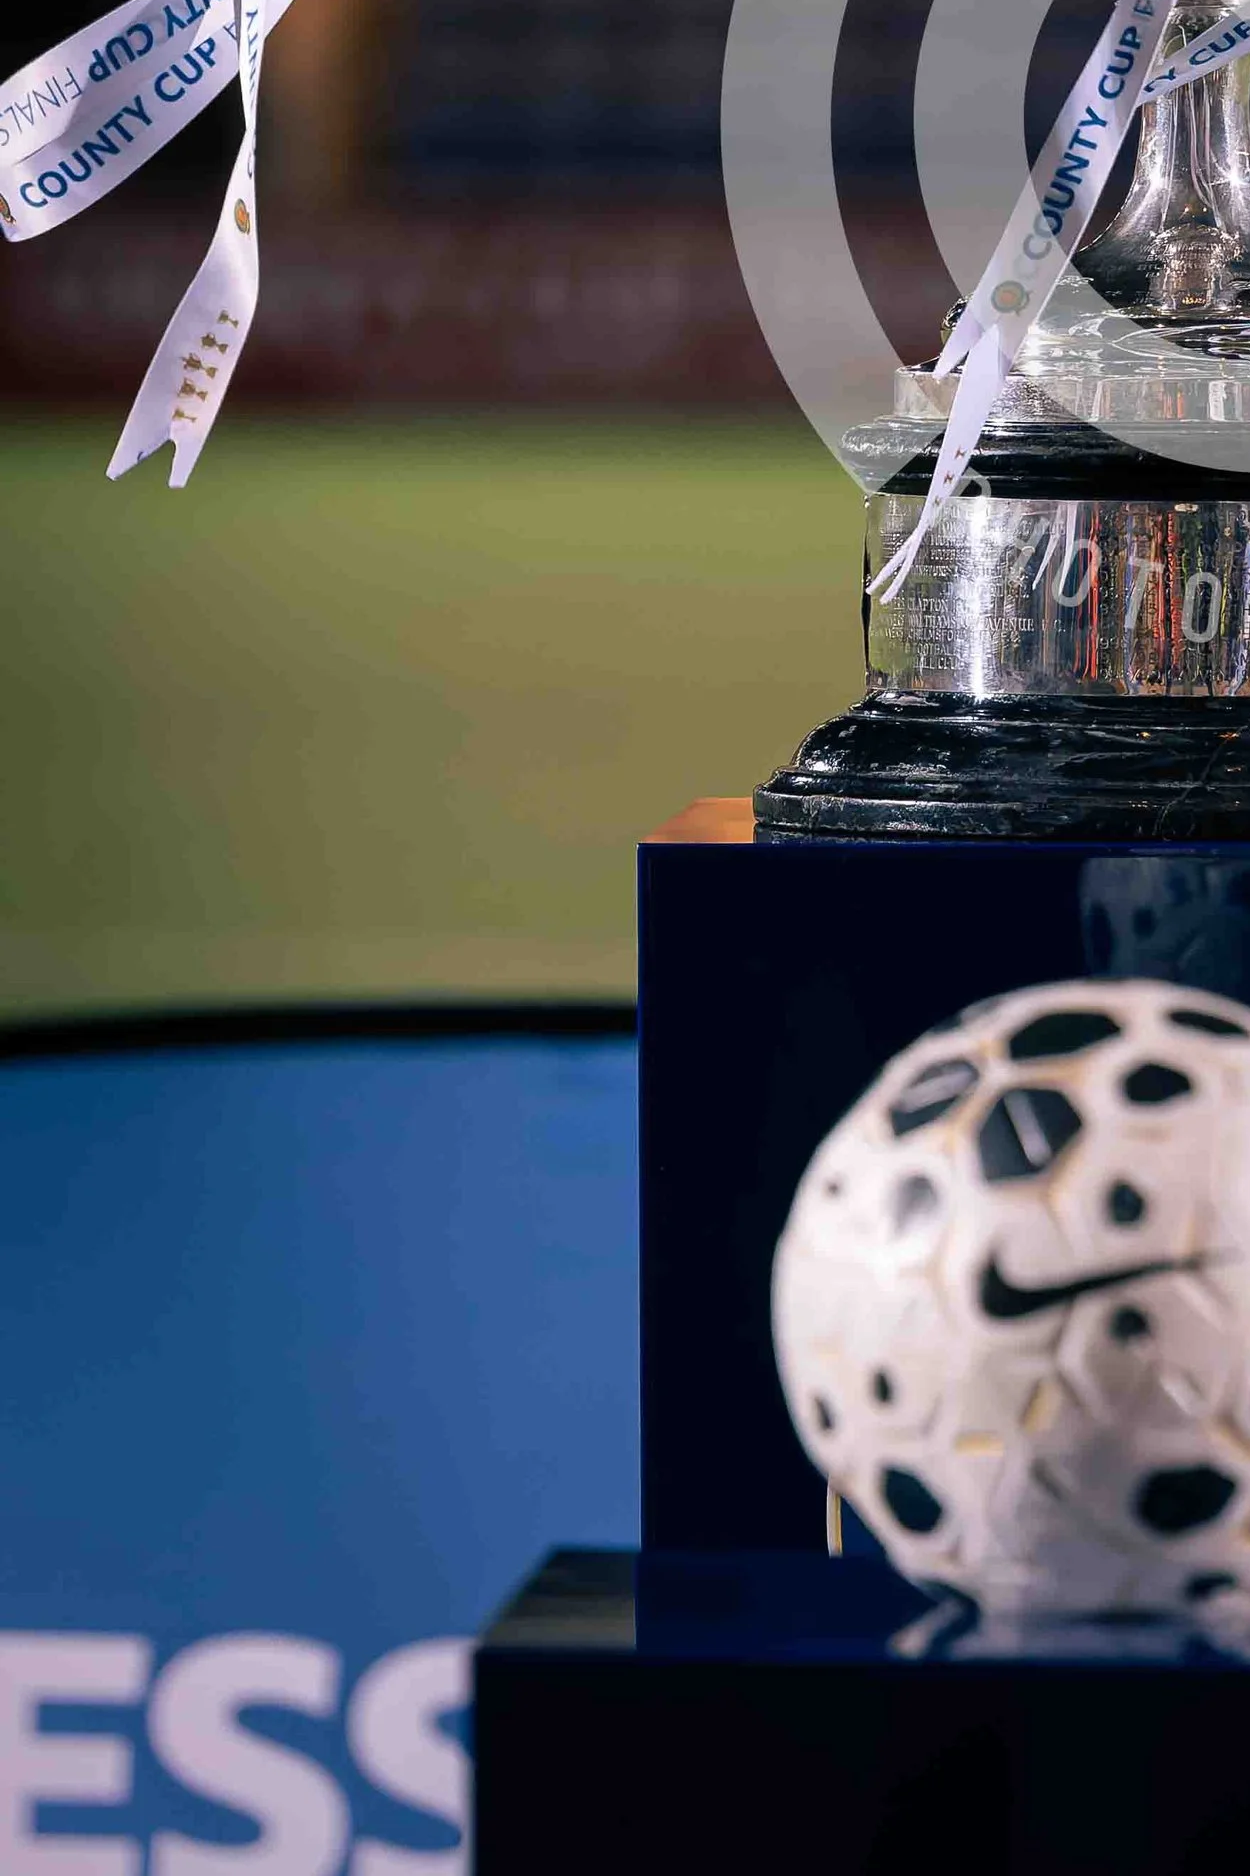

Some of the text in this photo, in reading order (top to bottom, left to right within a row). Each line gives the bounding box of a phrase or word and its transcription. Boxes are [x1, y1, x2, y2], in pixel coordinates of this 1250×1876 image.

[19, 95, 153, 208] COUNTY
[153, 37, 216, 103] CUP
[87, 23, 154, 83] CUP
[1022, 105, 1109, 262] COUNTY
[1097, 25, 1144, 100] CUP
[0, 1631, 472, 1876] ESS
